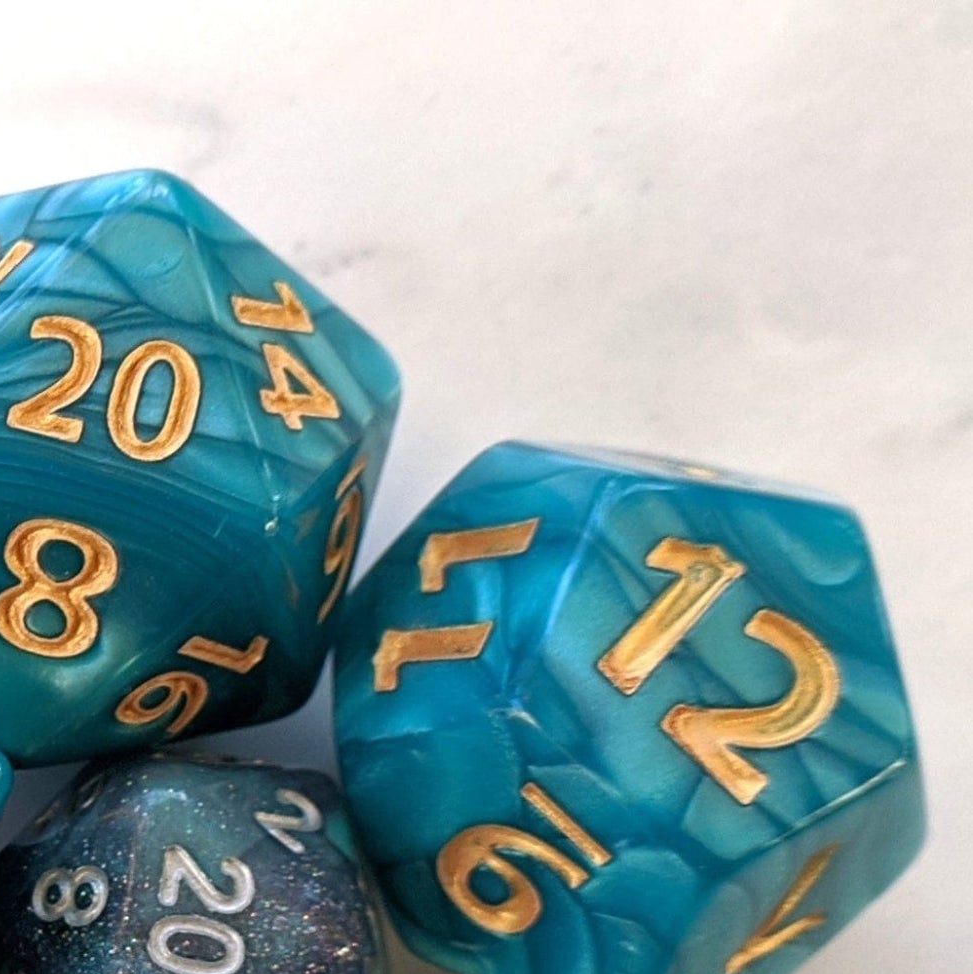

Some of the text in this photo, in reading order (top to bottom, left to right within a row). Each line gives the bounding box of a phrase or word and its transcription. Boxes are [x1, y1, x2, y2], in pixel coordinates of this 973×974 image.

[6, 315, 202, 463] 20
[230, 282, 341, 431] 14
[372, 518, 540, 693] 11
[597, 535, 842, 807] 12
[254, 789, 323, 854] 2
[31, 865, 109, 927] 8
